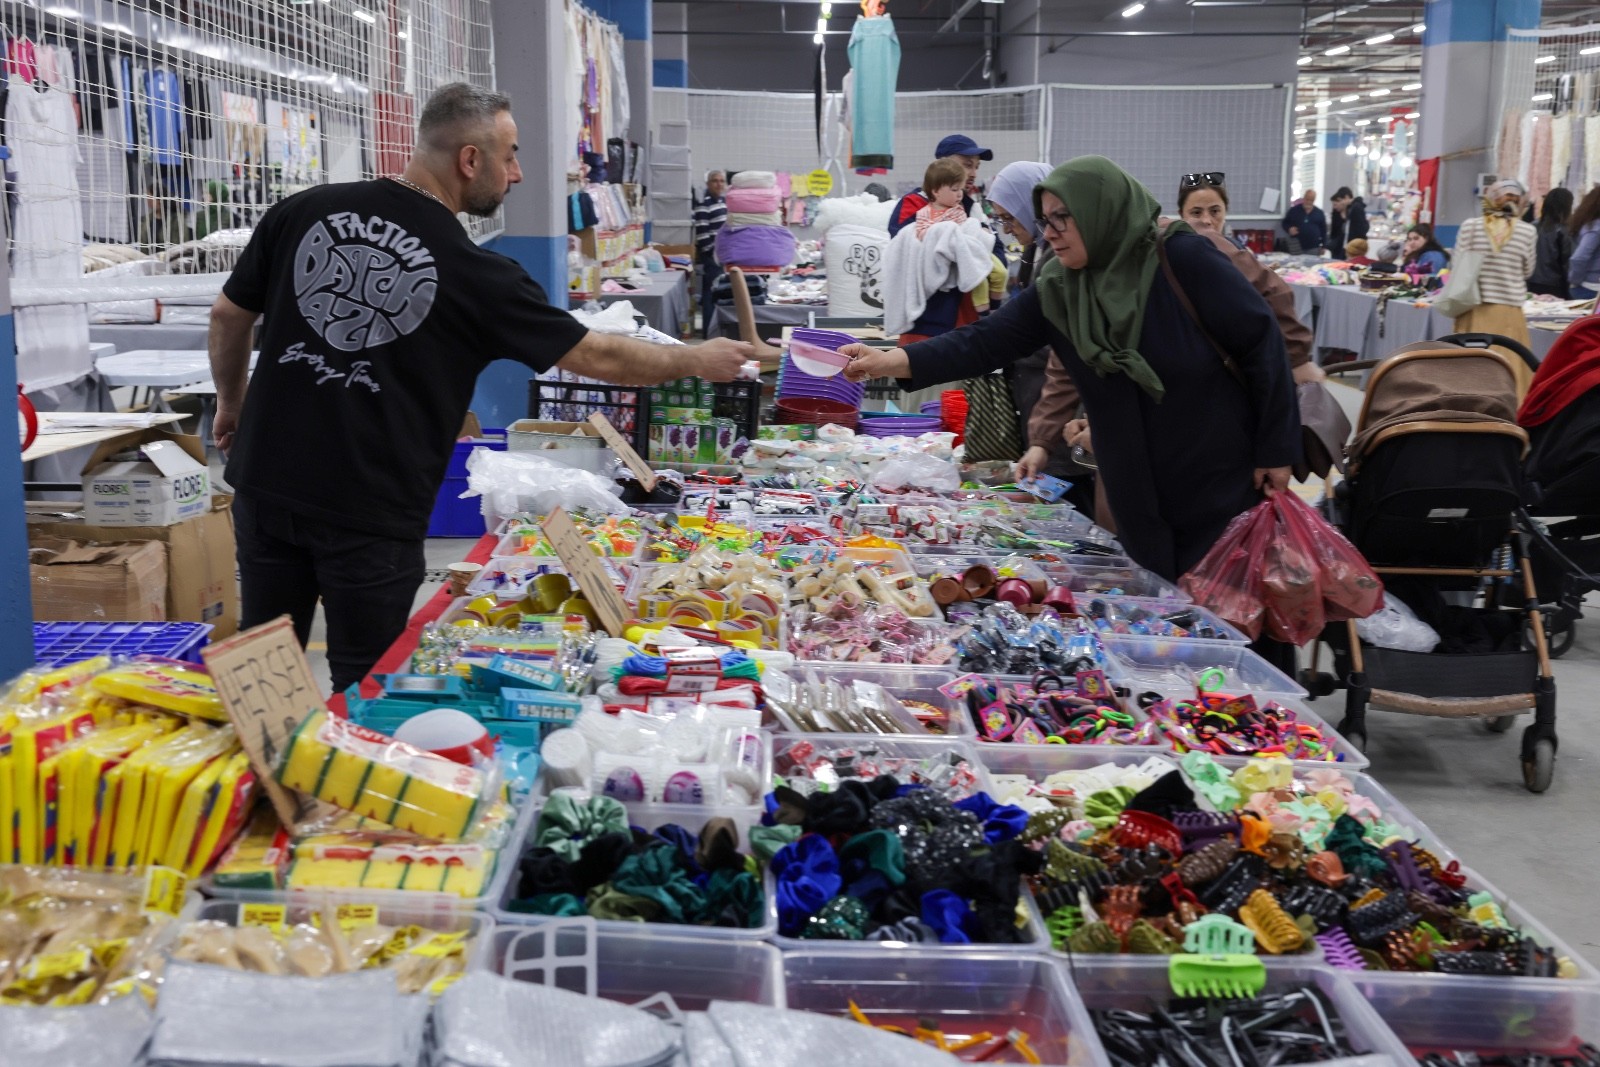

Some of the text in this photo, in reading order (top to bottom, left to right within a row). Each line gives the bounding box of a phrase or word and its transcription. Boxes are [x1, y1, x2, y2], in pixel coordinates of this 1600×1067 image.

[327, 211, 435, 268] FACTION
[278, 342, 346, 385] Every
[93, 484, 129, 494] FLOREX
[173, 474, 208, 499] FLOREX
